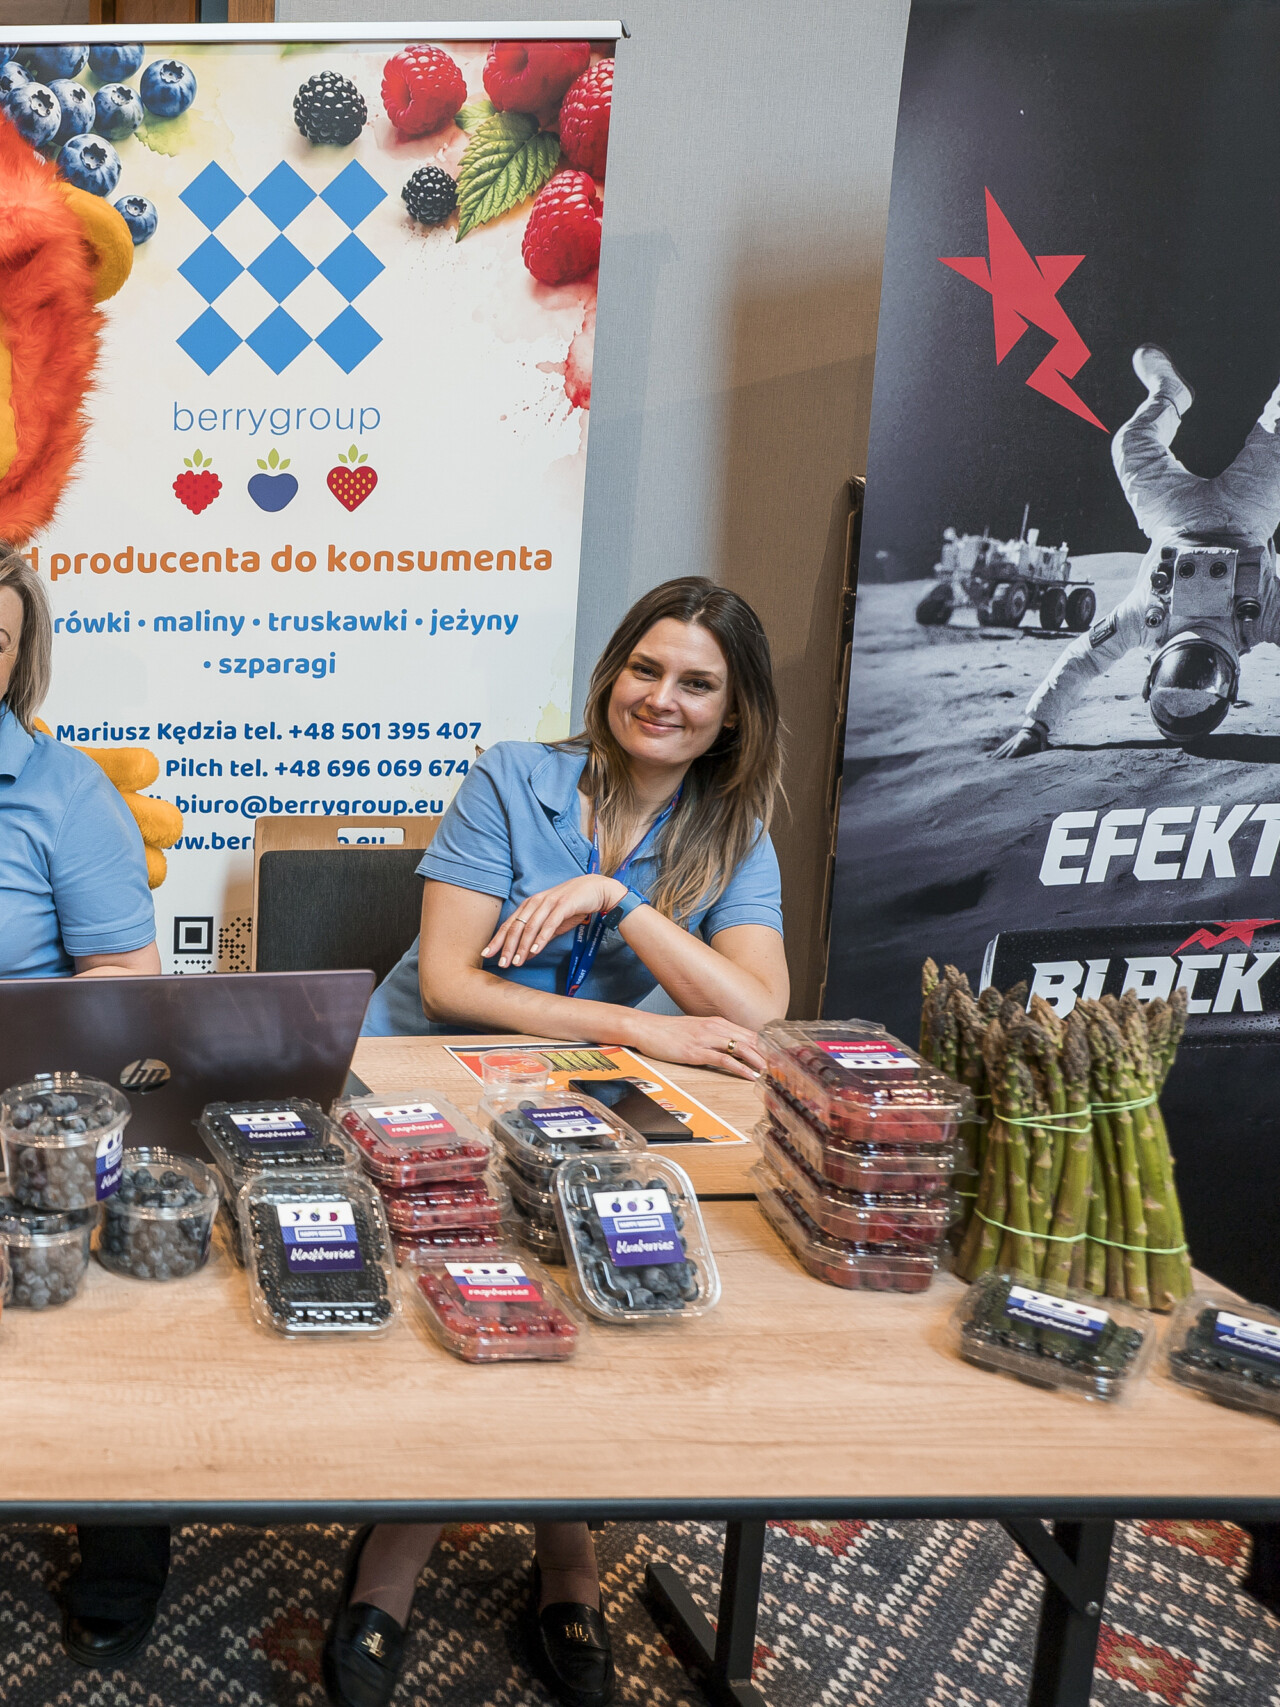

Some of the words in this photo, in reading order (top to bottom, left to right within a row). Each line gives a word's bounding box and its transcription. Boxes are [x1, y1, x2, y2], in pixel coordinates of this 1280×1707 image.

[173, 401, 381, 436] berrygroup
[50, 546, 261, 581] producenta
[270, 544, 317, 573] do
[327, 544, 553, 572] konsumenta
[53, 609, 131, 634] rówki
[153, 609, 245, 636] maliny
[268, 608, 408, 632] truskawki
[429, 608, 519, 636] jeżyny
[219, 651, 337, 679] szparagi
[56, 721, 151, 742] Mariusz
[157, 720, 237, 745] Kędzia
[244, 721, 283, 740] tel.
[288, 722, 335, 740] +48
[341, 722, 381, 740] 501
[387, 722, 430, 740] 395
[436, 722, 482, 740] 407
[166, 757, 223, 777] Pilch
[230, 758, 269, 777] tel.
[274, 759, 321, 777] +48
[327, 759, 370, 777] 696
[377, 759, 422, 777] 069
[428, 759, 470, 777] 674
[175, 794, 444, 819] biuro@berrygroup.eu
[1038, 803, 1280, 886] EFEKT
[290, 1246, 356, 1262] blackberries
[615, 1239, 675, 1254] blueberries
